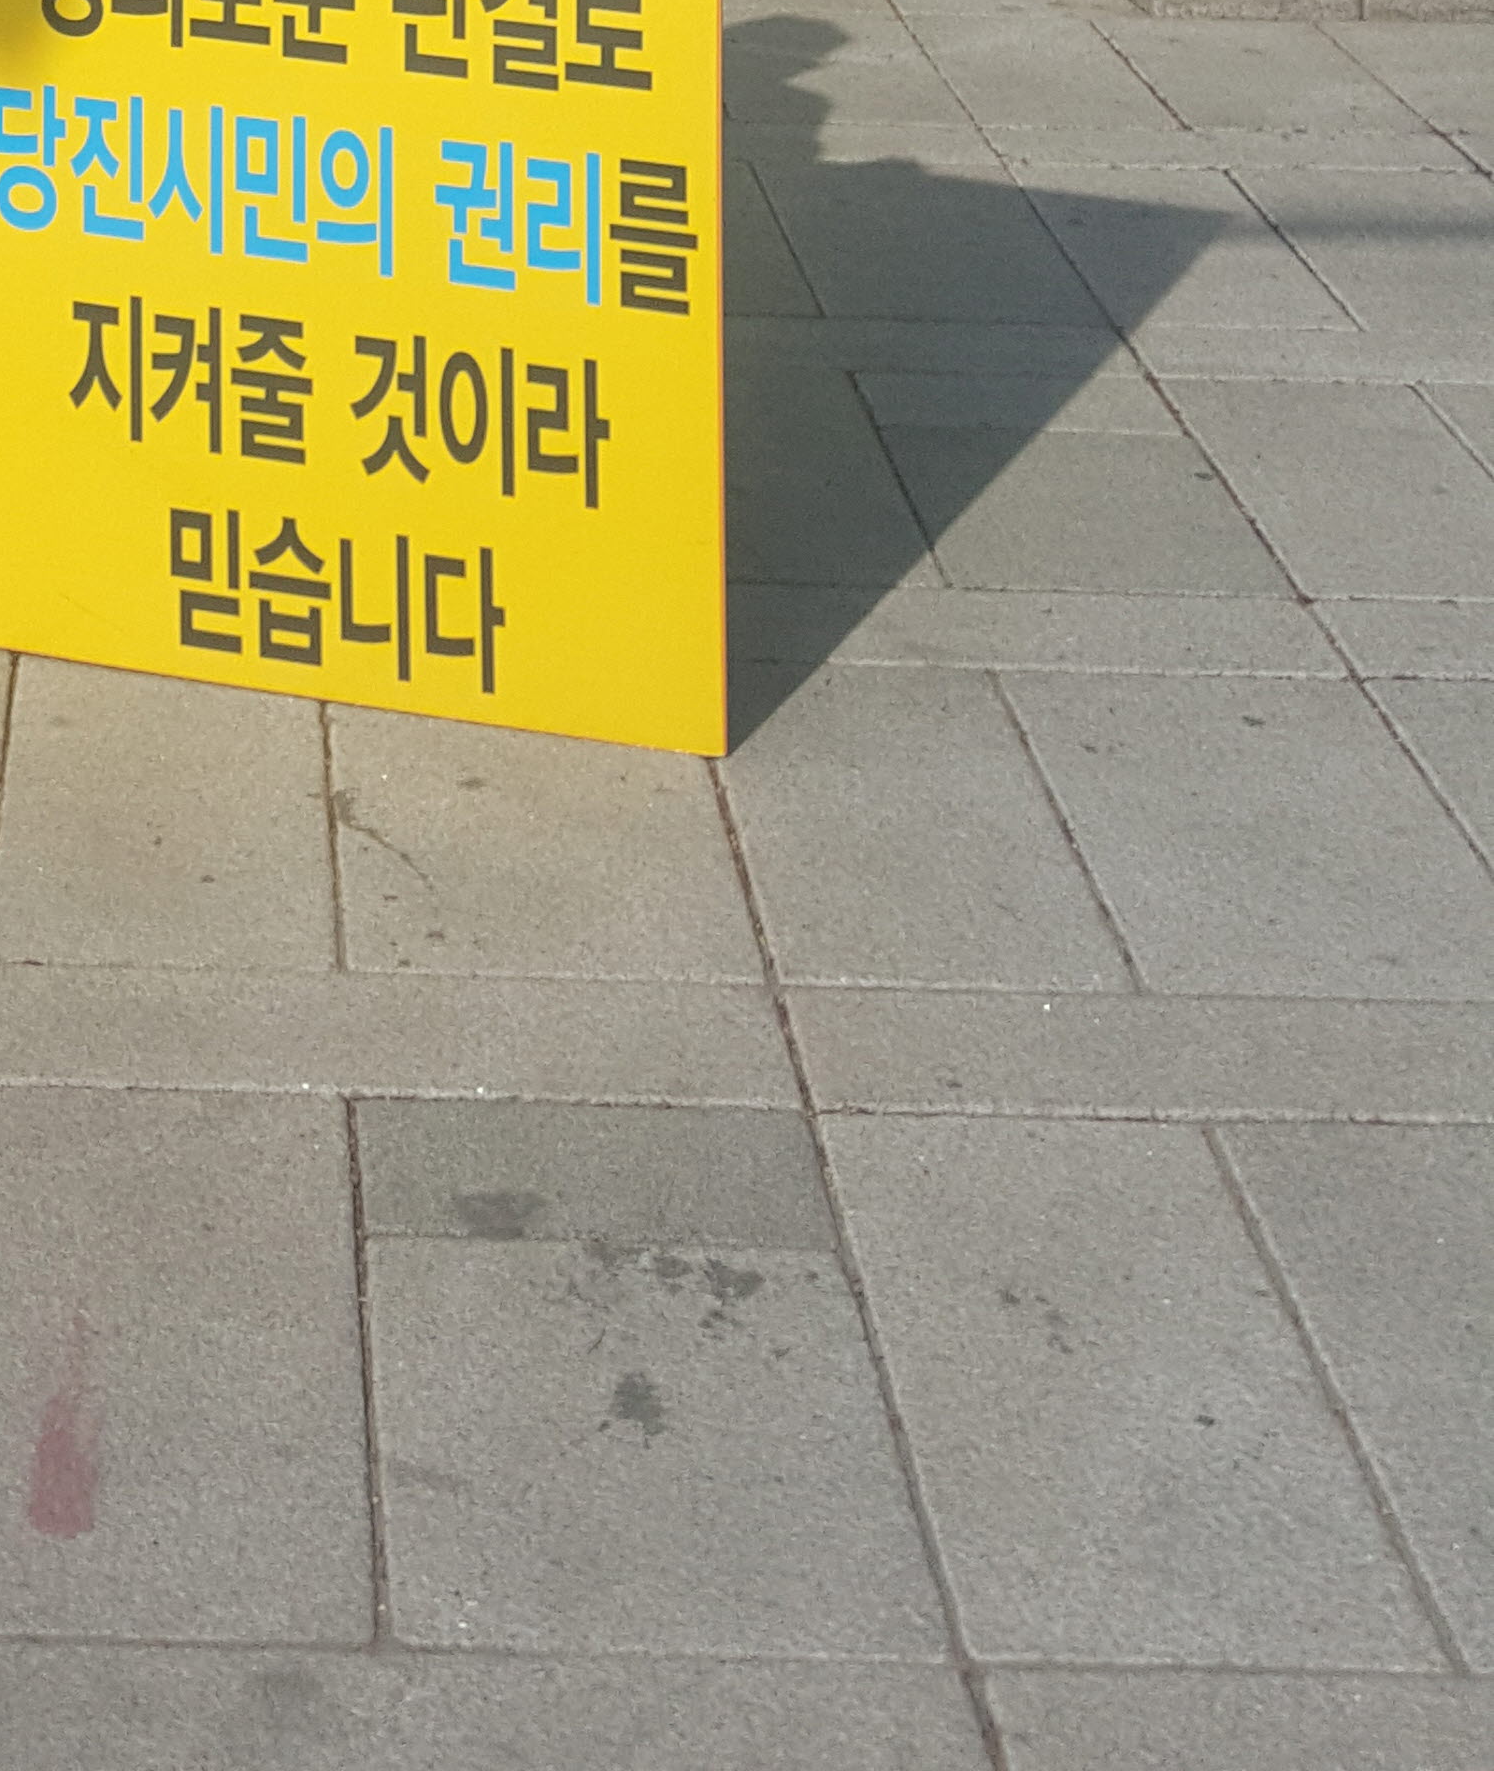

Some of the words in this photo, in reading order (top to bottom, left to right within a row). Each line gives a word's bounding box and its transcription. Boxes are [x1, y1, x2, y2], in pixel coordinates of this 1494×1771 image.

[434, 139, 696, 313] 권리를
[71, 298, 310, 462] 지켜줄
[354, 337, 608, 506] 것이라
[169, 507, 505, 695] 믿습니다
